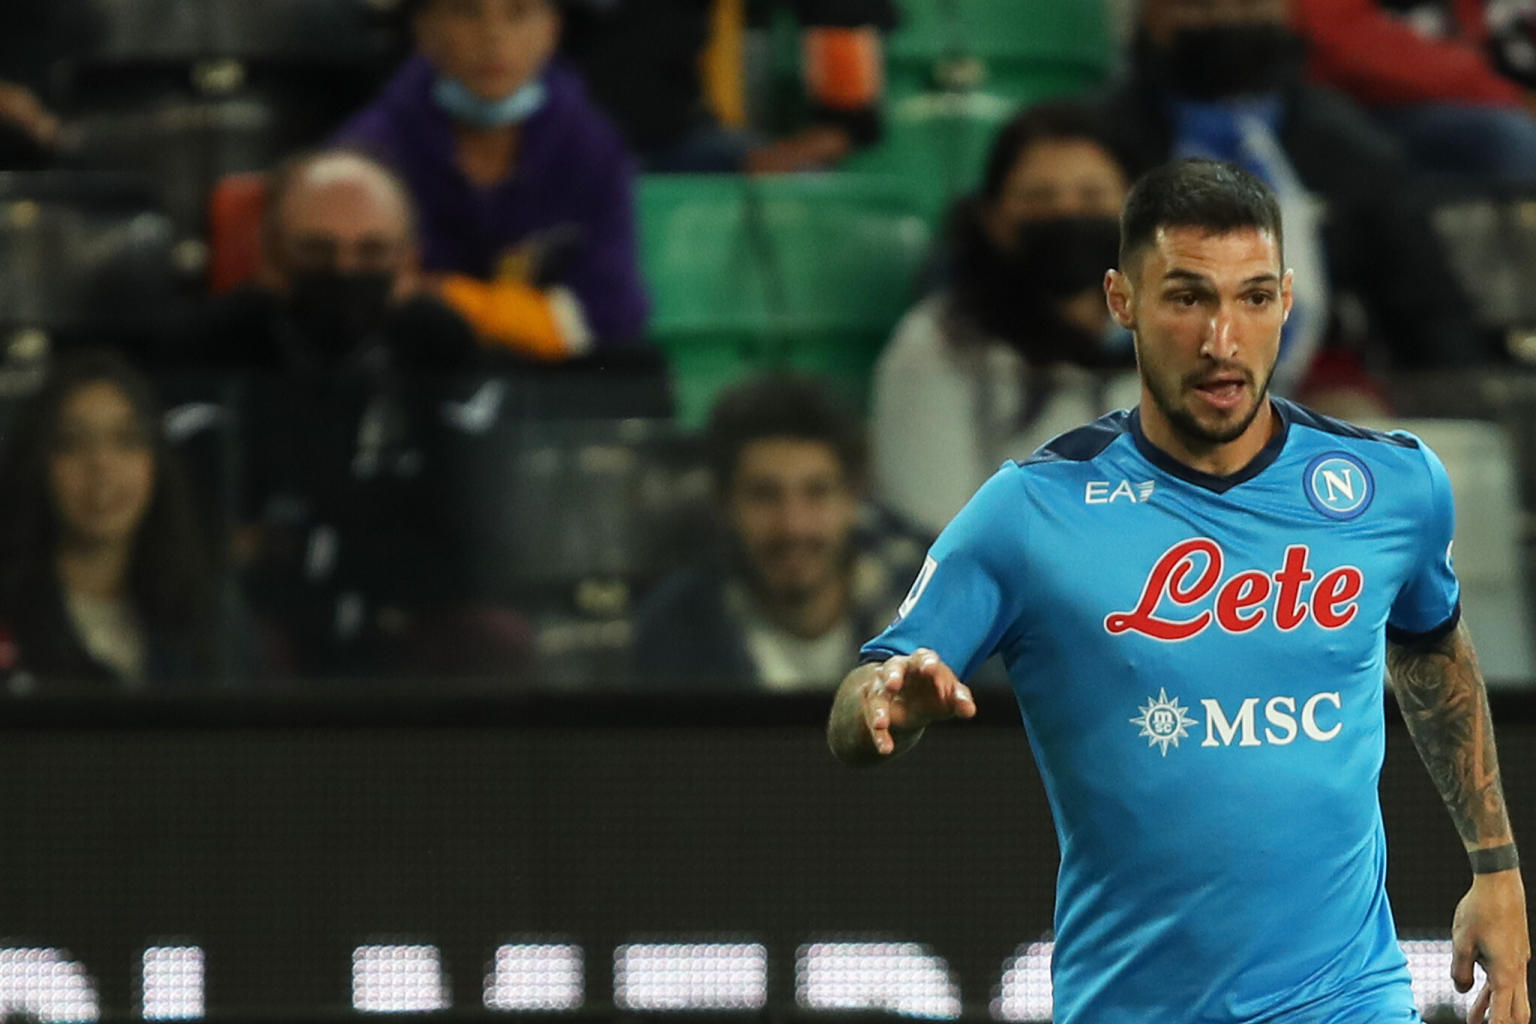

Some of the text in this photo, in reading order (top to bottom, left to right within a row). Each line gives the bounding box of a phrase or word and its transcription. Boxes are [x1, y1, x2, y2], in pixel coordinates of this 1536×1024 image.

[1321, 468, 1355, 501] N
[1103, 536, 1364, 642] Lete
[1201, 691, 1343, 747] MSC
